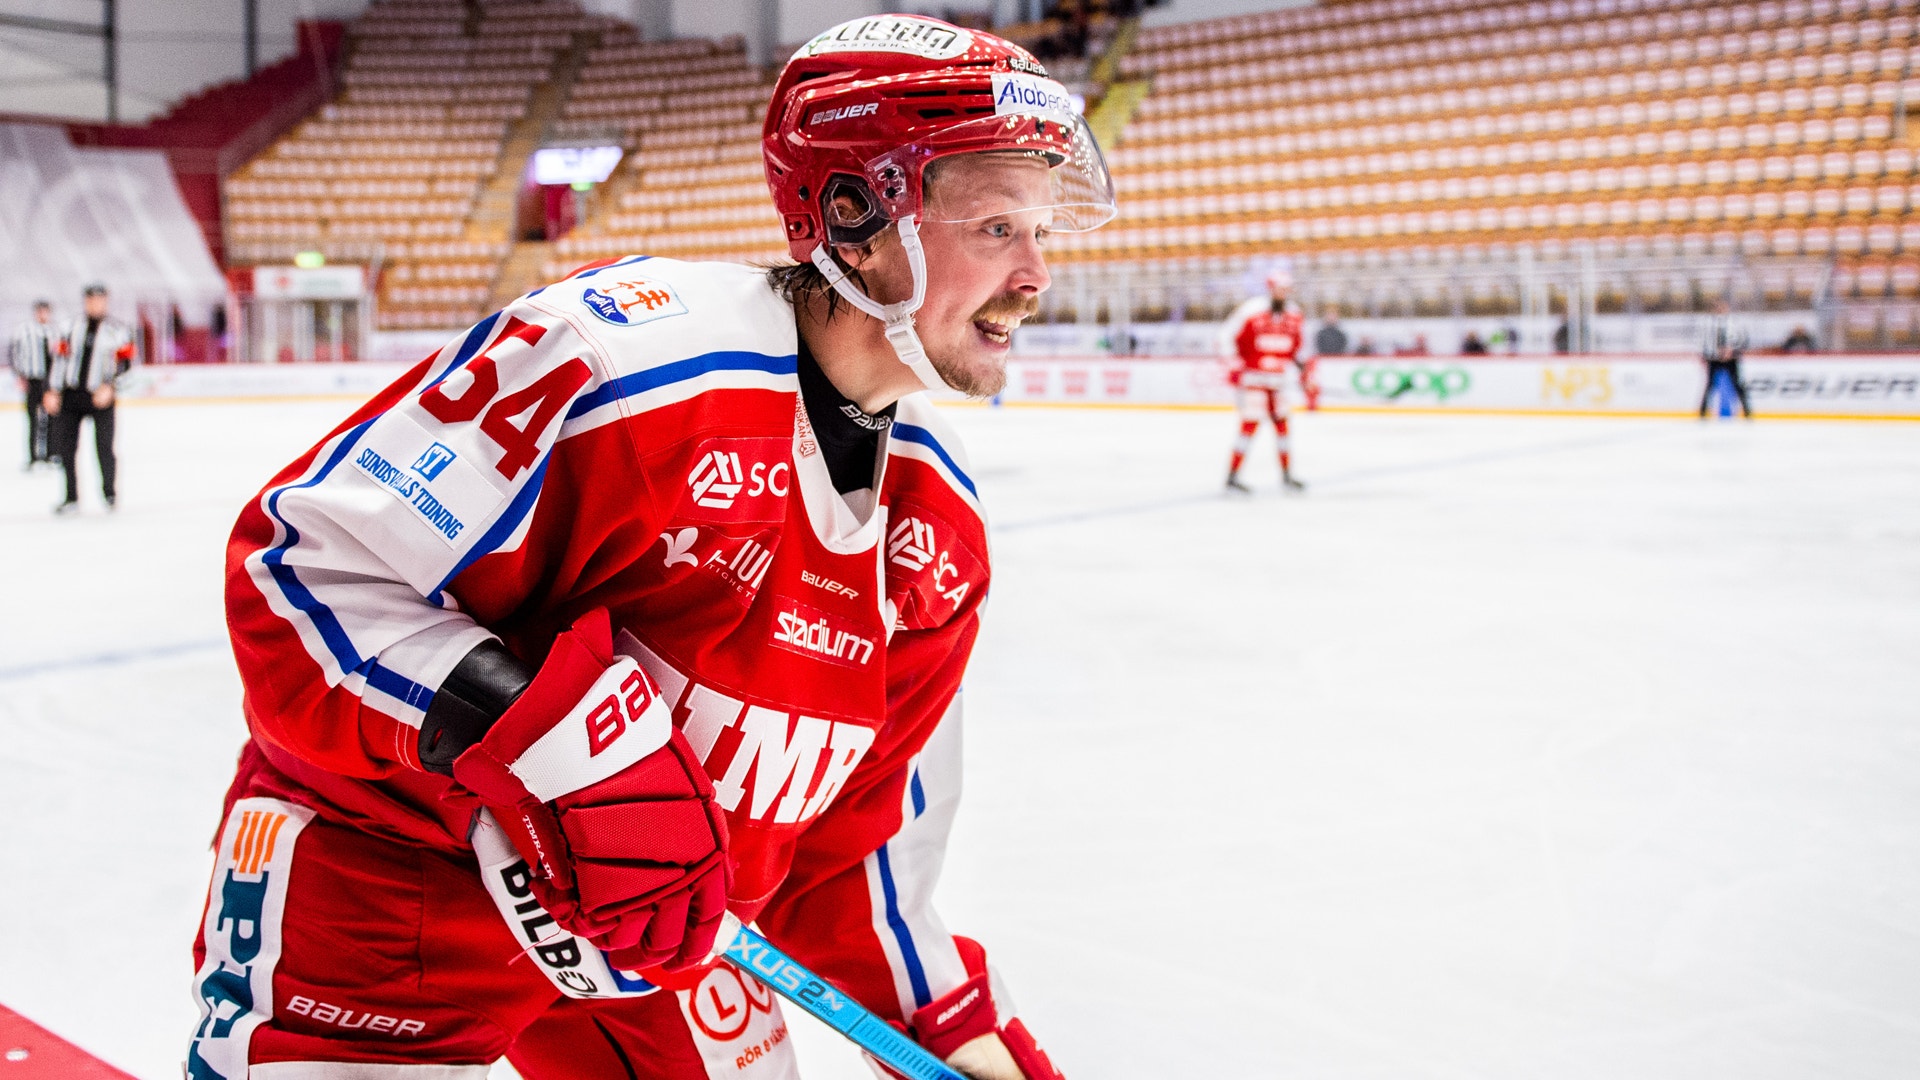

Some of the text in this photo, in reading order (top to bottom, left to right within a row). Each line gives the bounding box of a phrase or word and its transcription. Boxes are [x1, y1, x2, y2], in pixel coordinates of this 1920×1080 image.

[810, 102, 879, 125] BAUER
[418, 315, 593, 481] 54
[356, 448, 464, 540] SUNDSVALLS TIDNING
[801, 570, 859, 600] BAUER
[933, 551, 970, 611] SCA
[773, 608, 874, 665] stadium
[286, 995, 426, 1036] BAUER
[814, 1003, 836, 1018] PRO
[736, 1045, 764, 1070] RÖR
